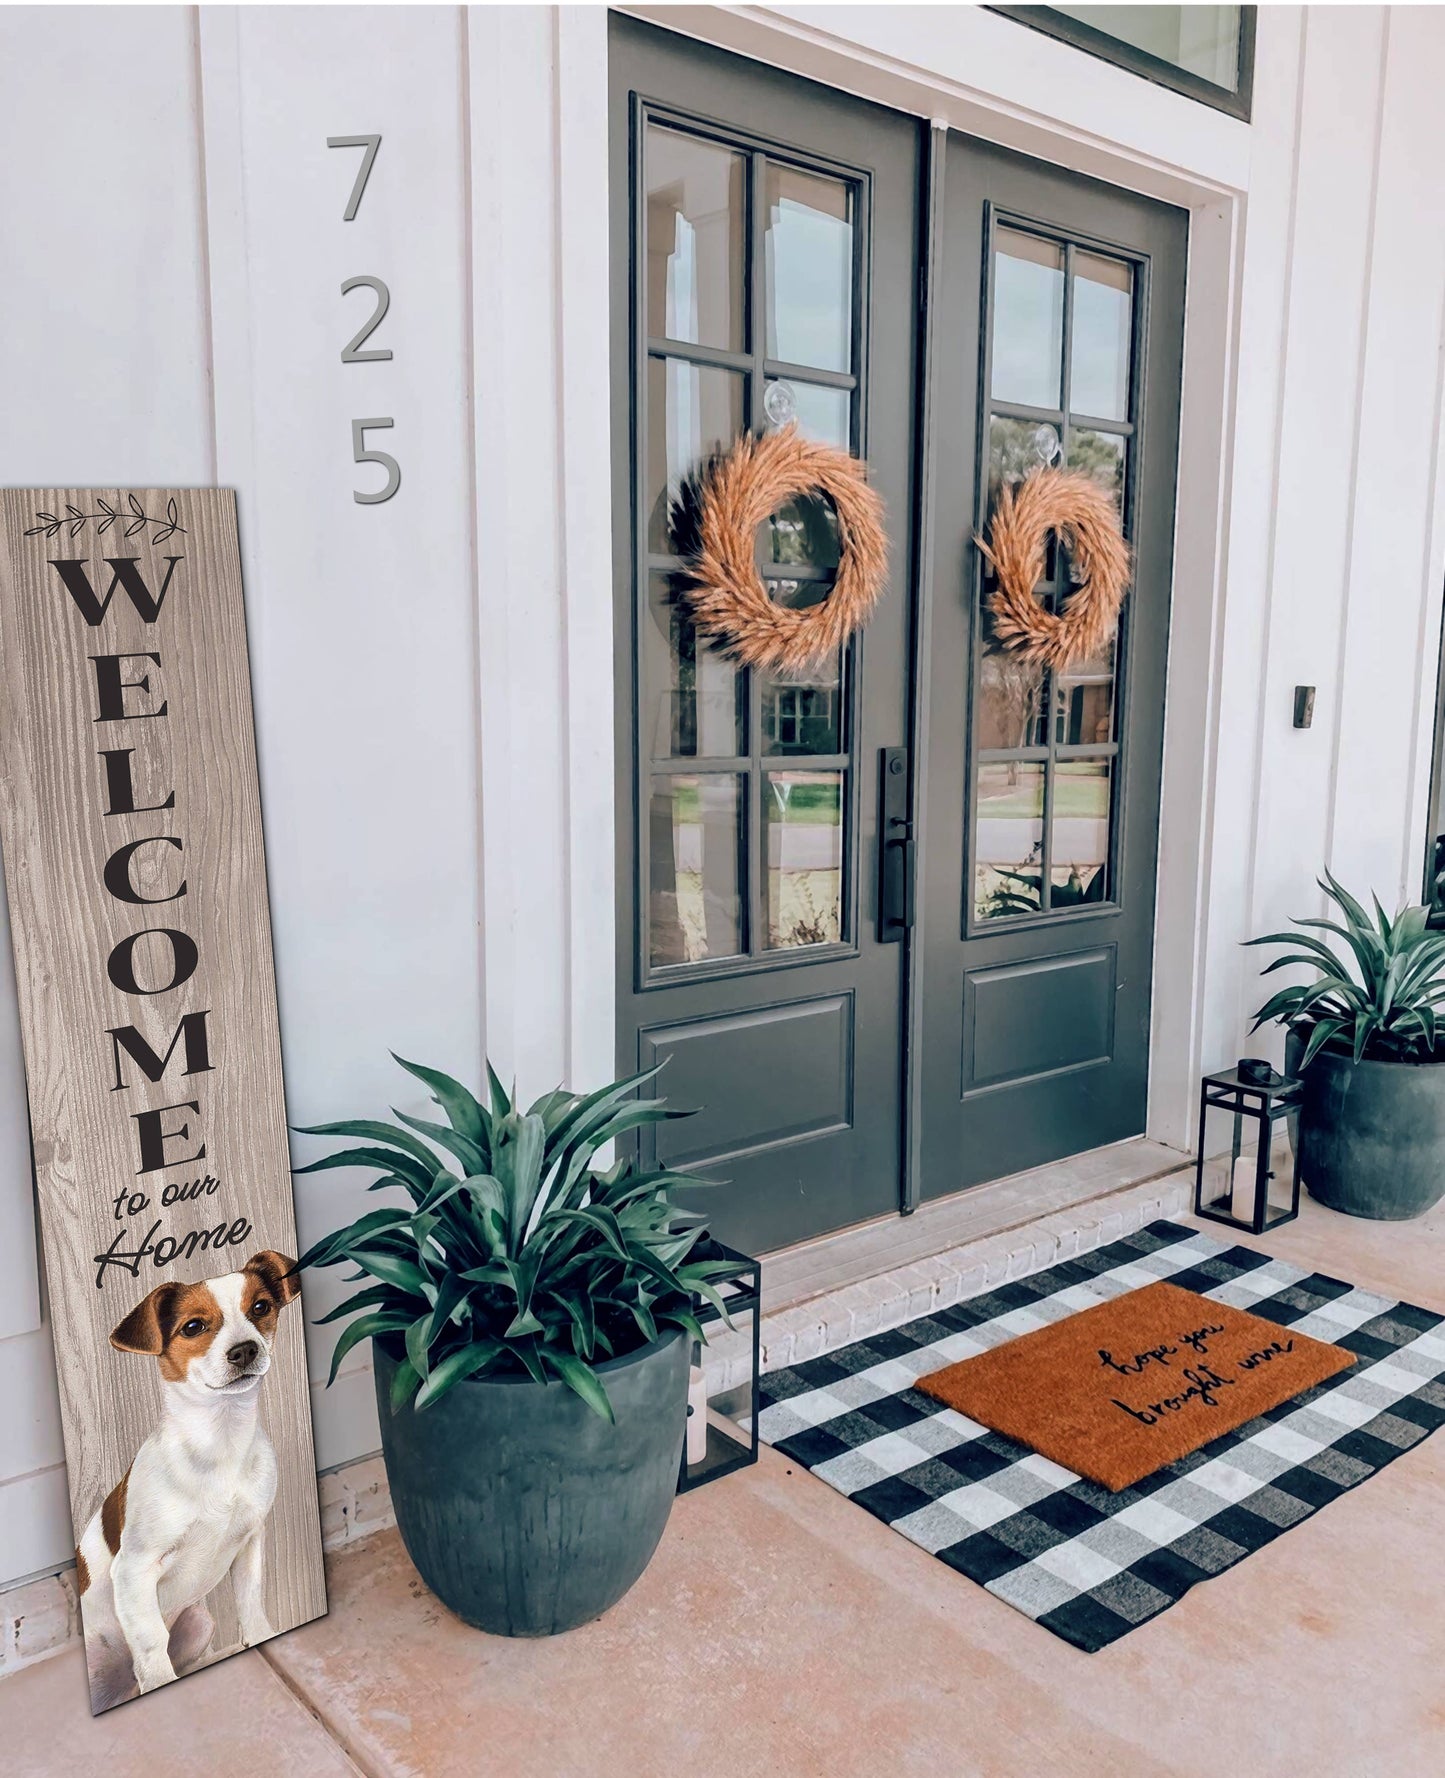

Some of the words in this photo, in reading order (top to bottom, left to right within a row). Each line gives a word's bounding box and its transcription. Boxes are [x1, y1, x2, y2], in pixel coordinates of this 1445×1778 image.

[326, 134, 402, 504] 725
[47, 555, 217, 1175] WELCOME
[113, 1185, 151, 1220] to
[162, 1175, 221, 1207] our
[93, 1217, 252, 1289] Home
[1098, 1344, 1178, 1376] hope
[1179, 1323, 1225, 1354] you
[1111, 1365, 1235, 1425] brought
